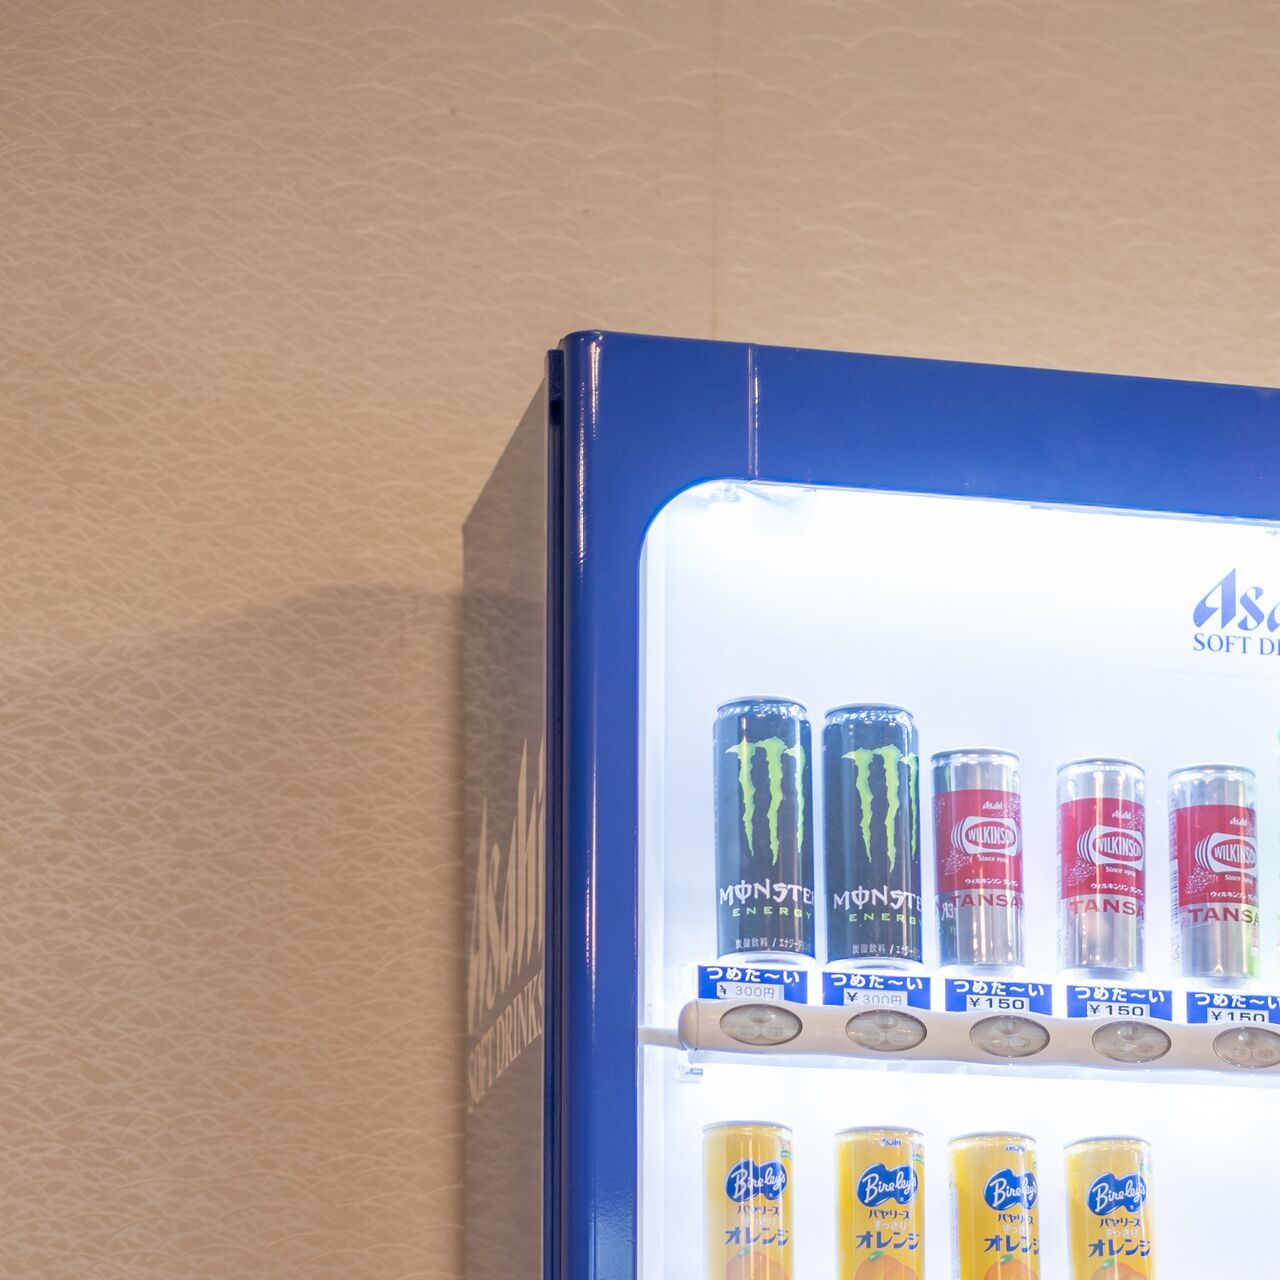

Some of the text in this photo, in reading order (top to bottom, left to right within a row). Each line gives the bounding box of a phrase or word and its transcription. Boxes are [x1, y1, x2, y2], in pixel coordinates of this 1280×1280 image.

[1193, 633, 1251, 654] SOFT
[967, 825, 1015, 845] WILKINSON
[1095, 835, 1143, 858] WILKINSON
[732, 906, 812, 919] ENERGY
[724, 1226, 789, 1247] オレンジ
[856, 1231, 920, 1250] オレンジ
[1087, 1239, 1151, 1257] オレンジ
